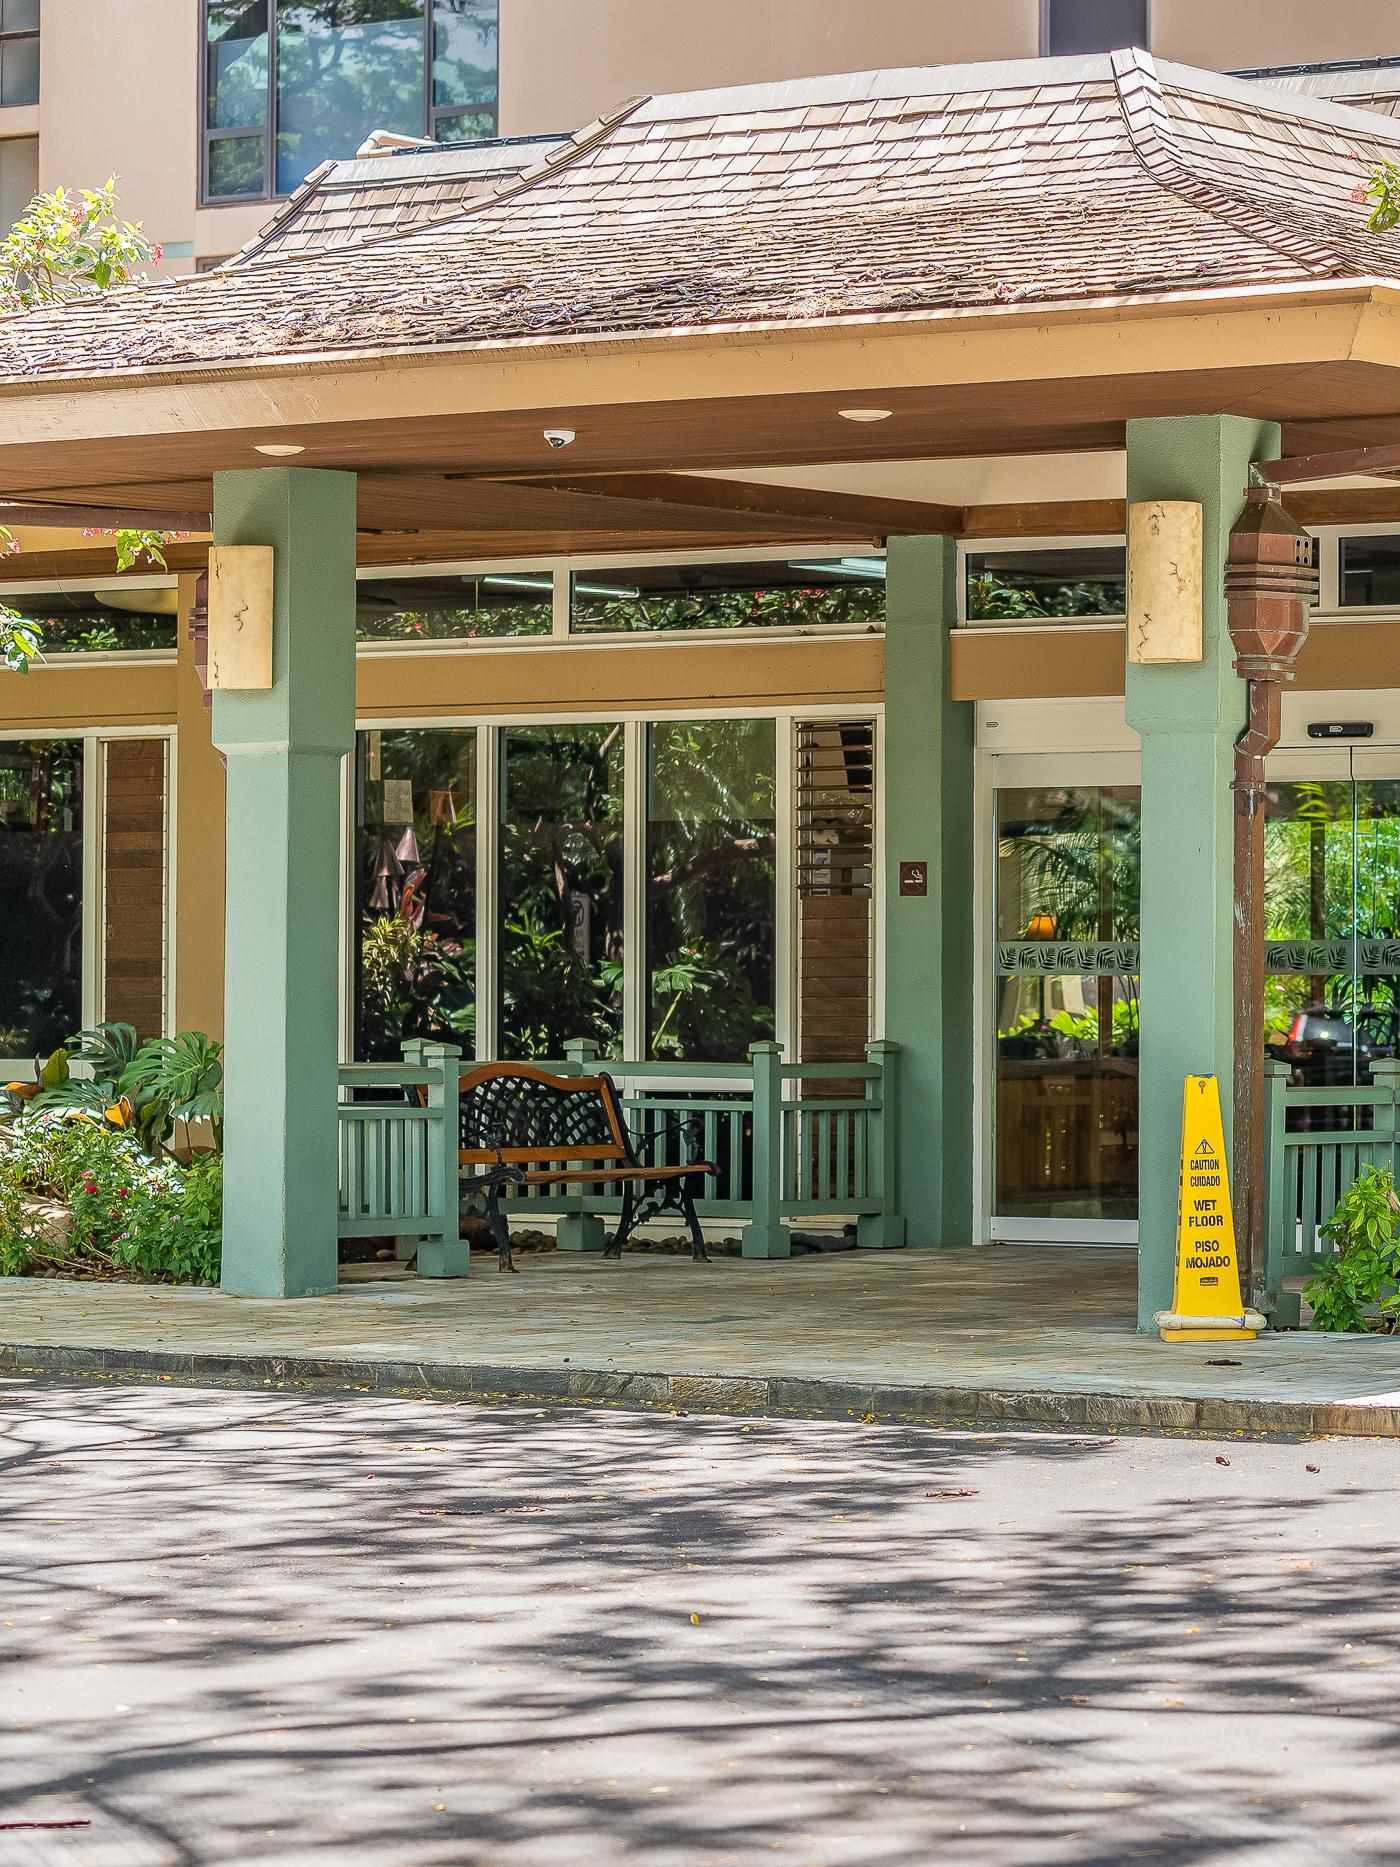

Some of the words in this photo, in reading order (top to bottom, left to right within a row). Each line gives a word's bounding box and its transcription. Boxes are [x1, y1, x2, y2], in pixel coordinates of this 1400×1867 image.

[1190, 1159, 1220, 1171] CAUTION
[1190, 1175, 1220, 1187] CUIDADO
[1193, 1199, 1217, 1211] WET
[1188, 1215, 1224, 1227] FLOOR
[1195, 1240, 1220, 1252] PISO
[1185, 1256, 1231, 1269] MOJADO
